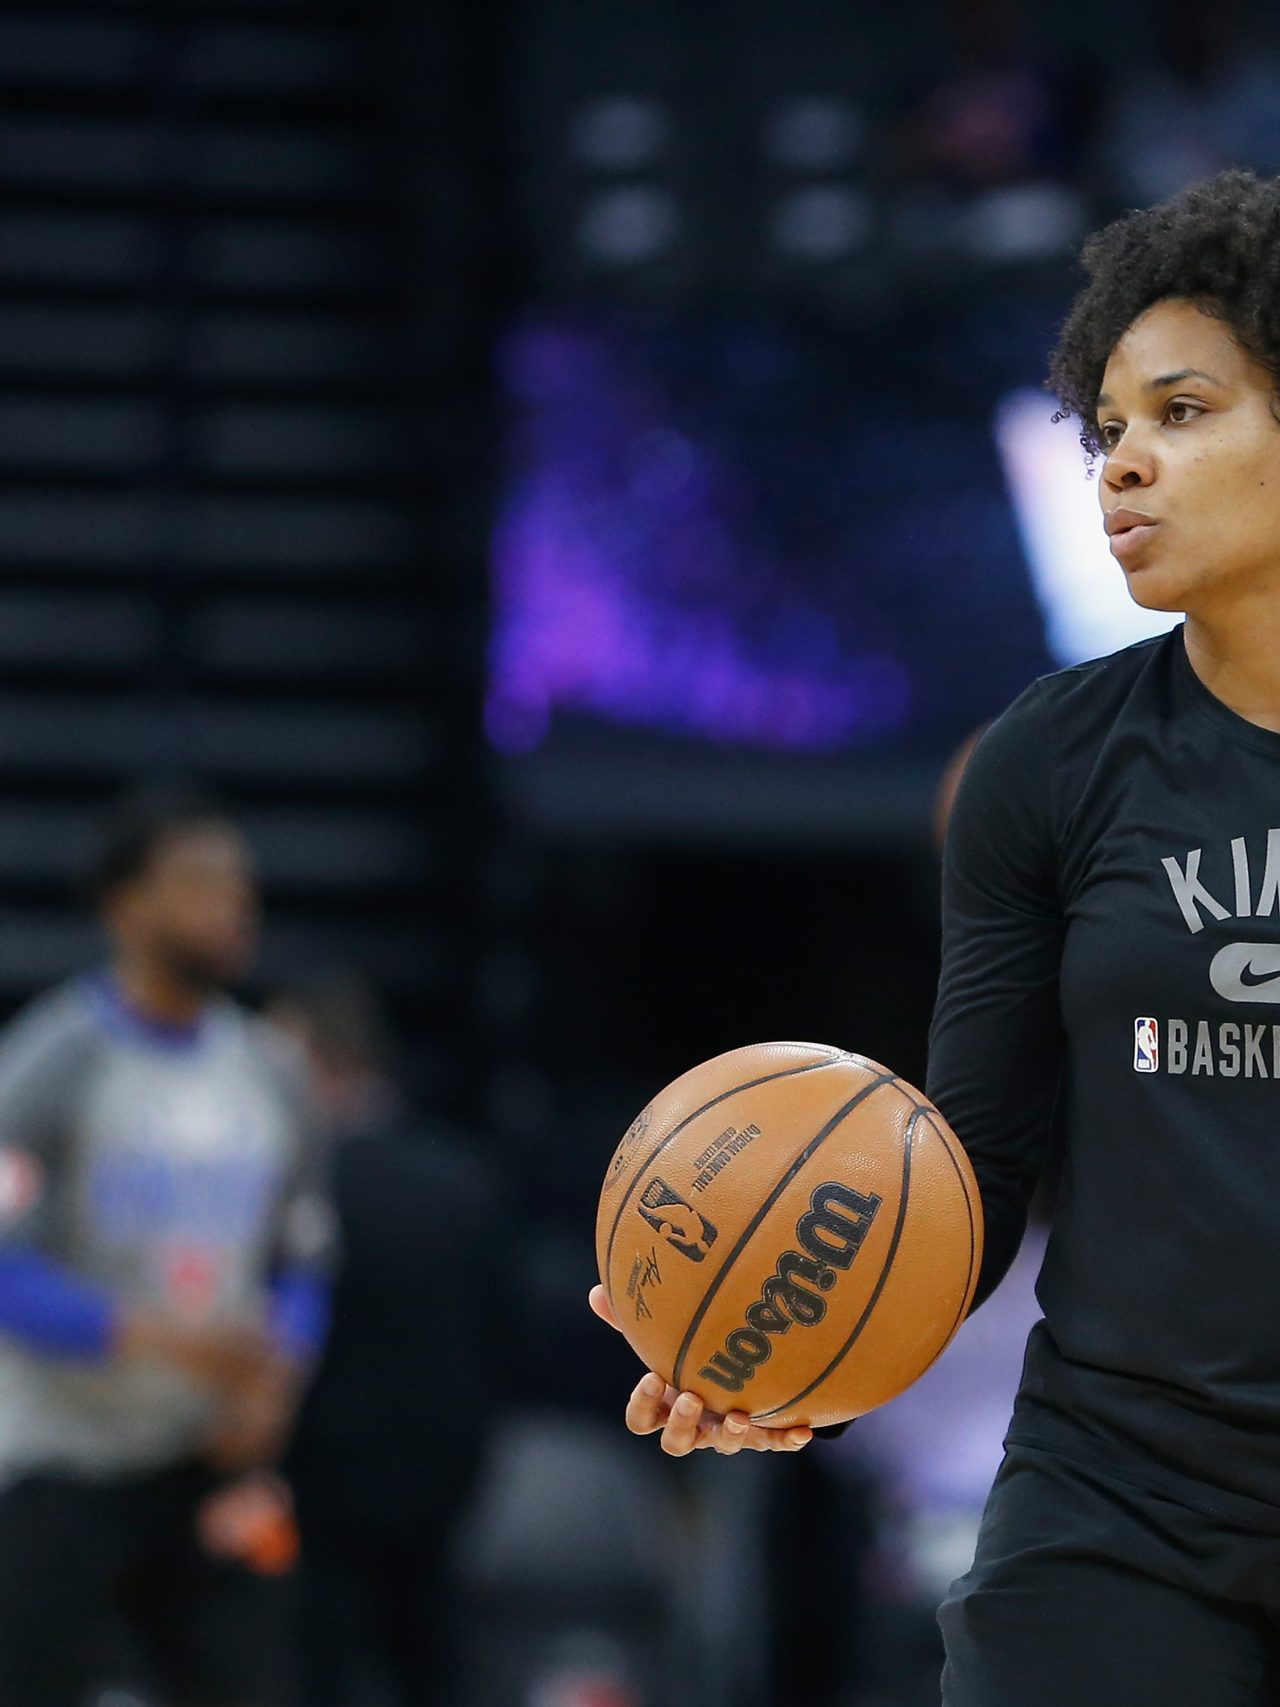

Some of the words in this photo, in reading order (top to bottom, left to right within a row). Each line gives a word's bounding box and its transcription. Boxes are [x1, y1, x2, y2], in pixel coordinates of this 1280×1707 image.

[725, 1124, 761, 1156] OFFICIAL
[706, 1151, 731, 1176] GAME
[692, 1170, 713, 1193] BALL
[697, 1181, 883, 1393] Wilson
